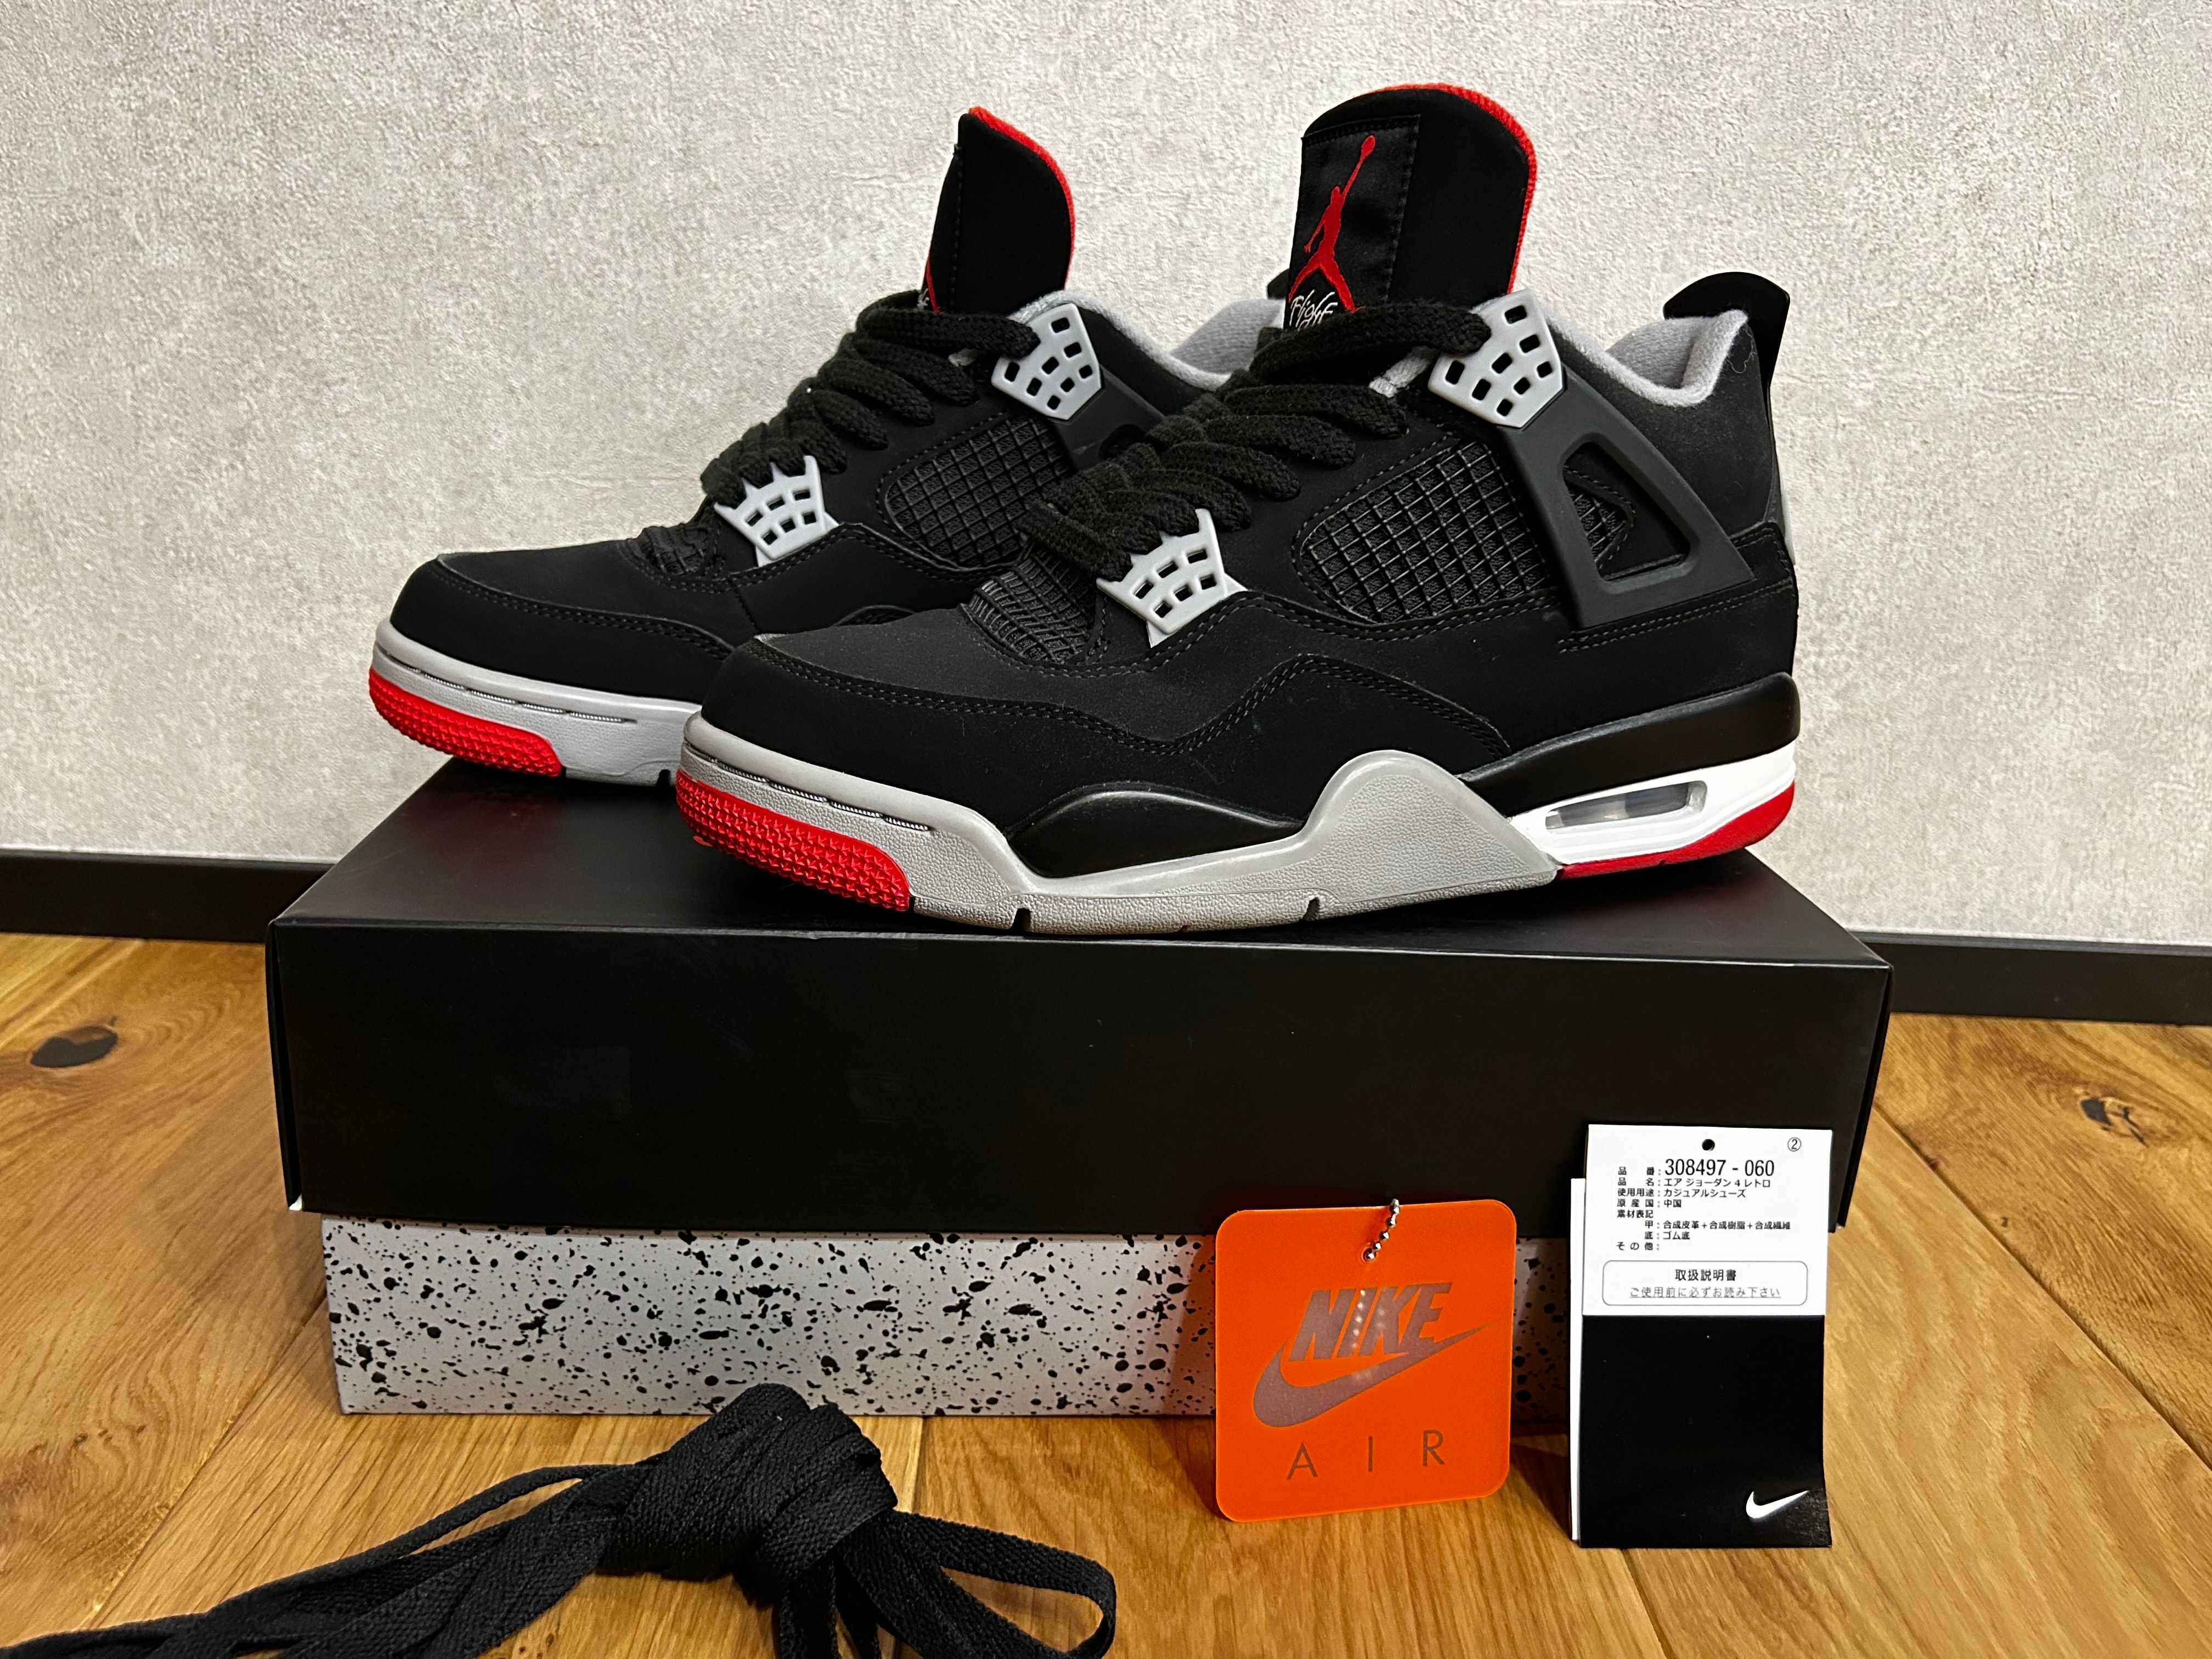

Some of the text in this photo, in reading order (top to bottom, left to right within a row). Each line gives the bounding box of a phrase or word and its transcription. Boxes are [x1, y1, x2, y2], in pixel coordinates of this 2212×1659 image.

[1665, 1159, 1726, 1176] 308497
[1745, 1160, 1774, 1176] 060
[1686, 1178, 1731, 1187] ジョーダン
[1745, 1179, 1770, 1187] レトロ
[1664, 1189, 1745, 1198] カジュアルシューズ
[1664, 1199, 1681, 1207] 中国
[1617, 1209, 1653, 1218] 素材表記
[1663, 1231, 1690, 1239] ゴム底
[1675, 1269, 1736, 1281] 取扱説明書
[1630, 1286, 1779, 1296] ご使用前に必ずお読み下さい
[1288, 1282, 1453, 1362] NIKE
[1286, 1429, 1445, 1481] AIR
